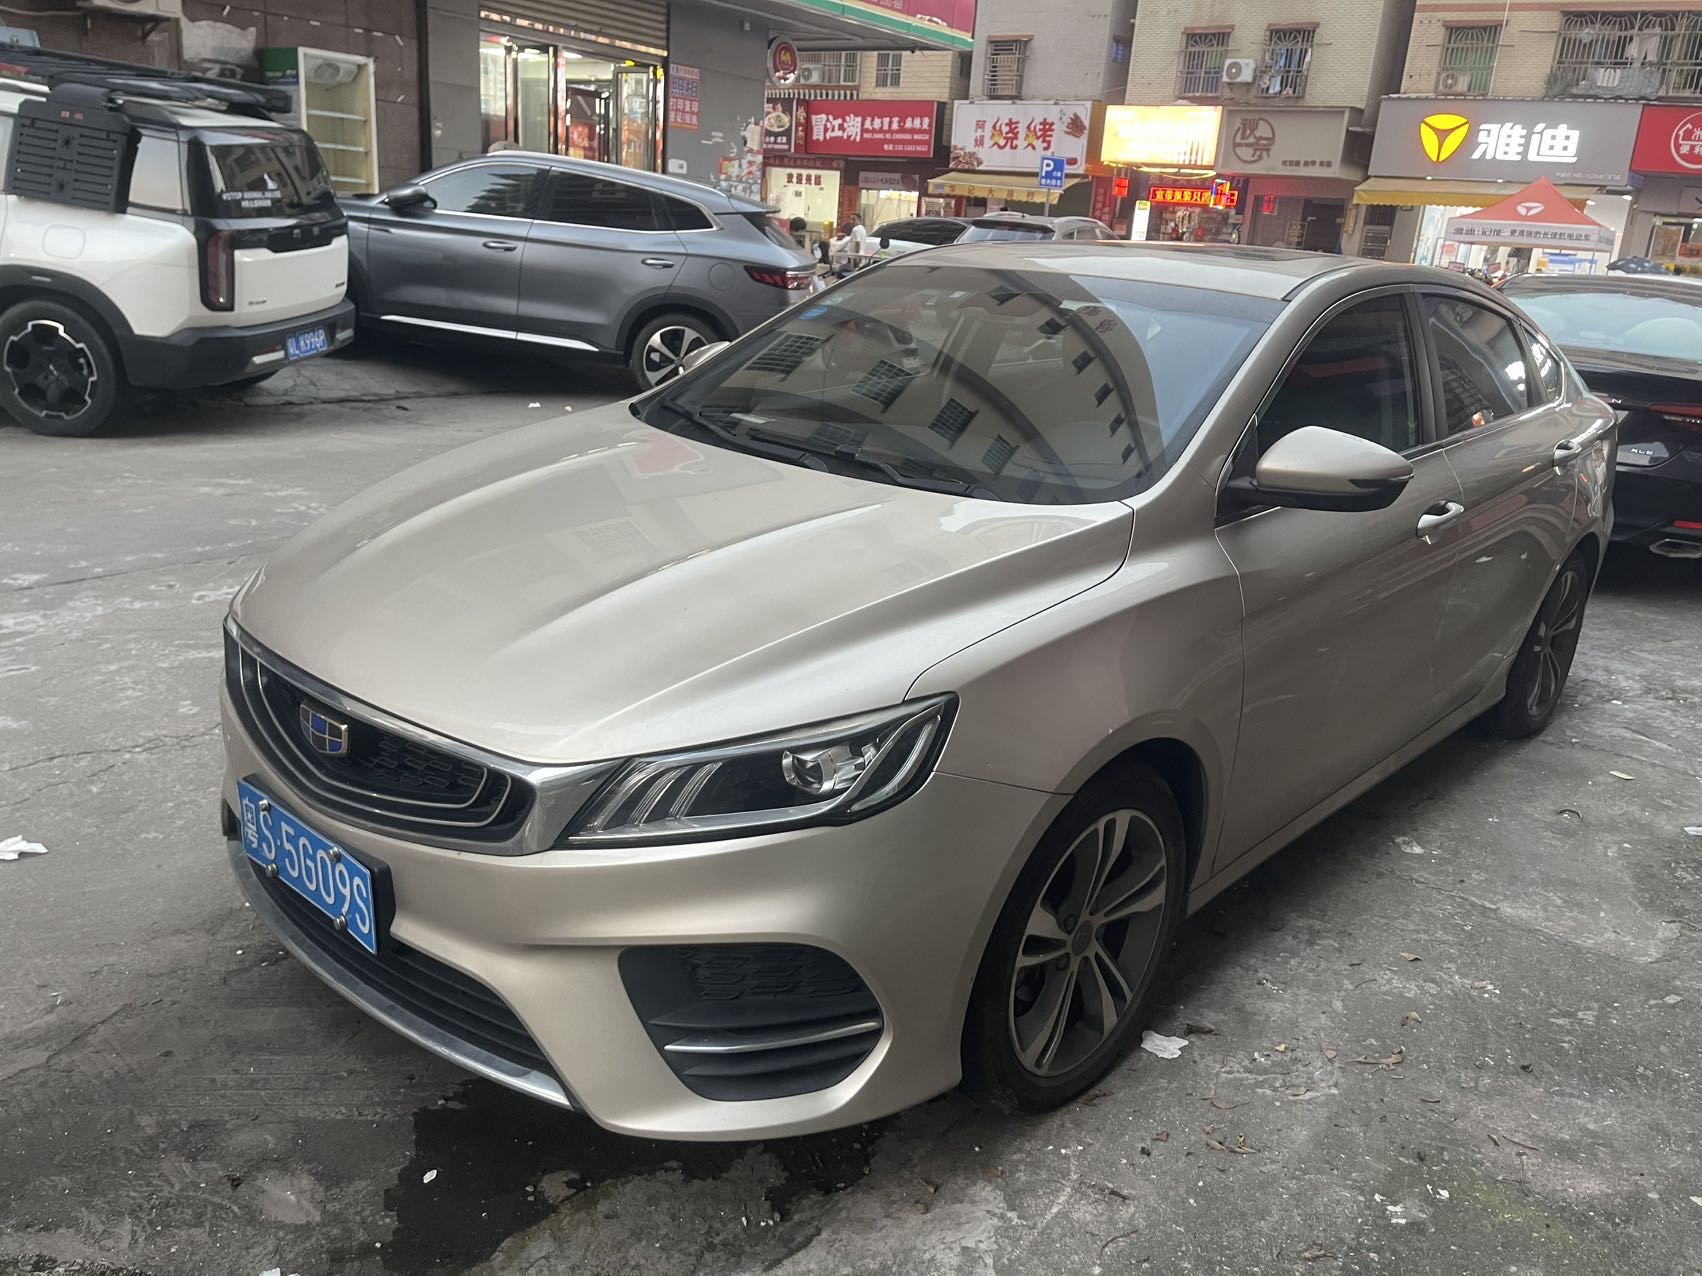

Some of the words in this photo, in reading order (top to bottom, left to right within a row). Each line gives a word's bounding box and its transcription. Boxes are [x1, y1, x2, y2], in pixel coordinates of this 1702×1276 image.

[989, 111, 1056, 151] 烧烤
[1470, 121, 1581, 164] 雅迪
[1042, 159, 1054, 177] P
